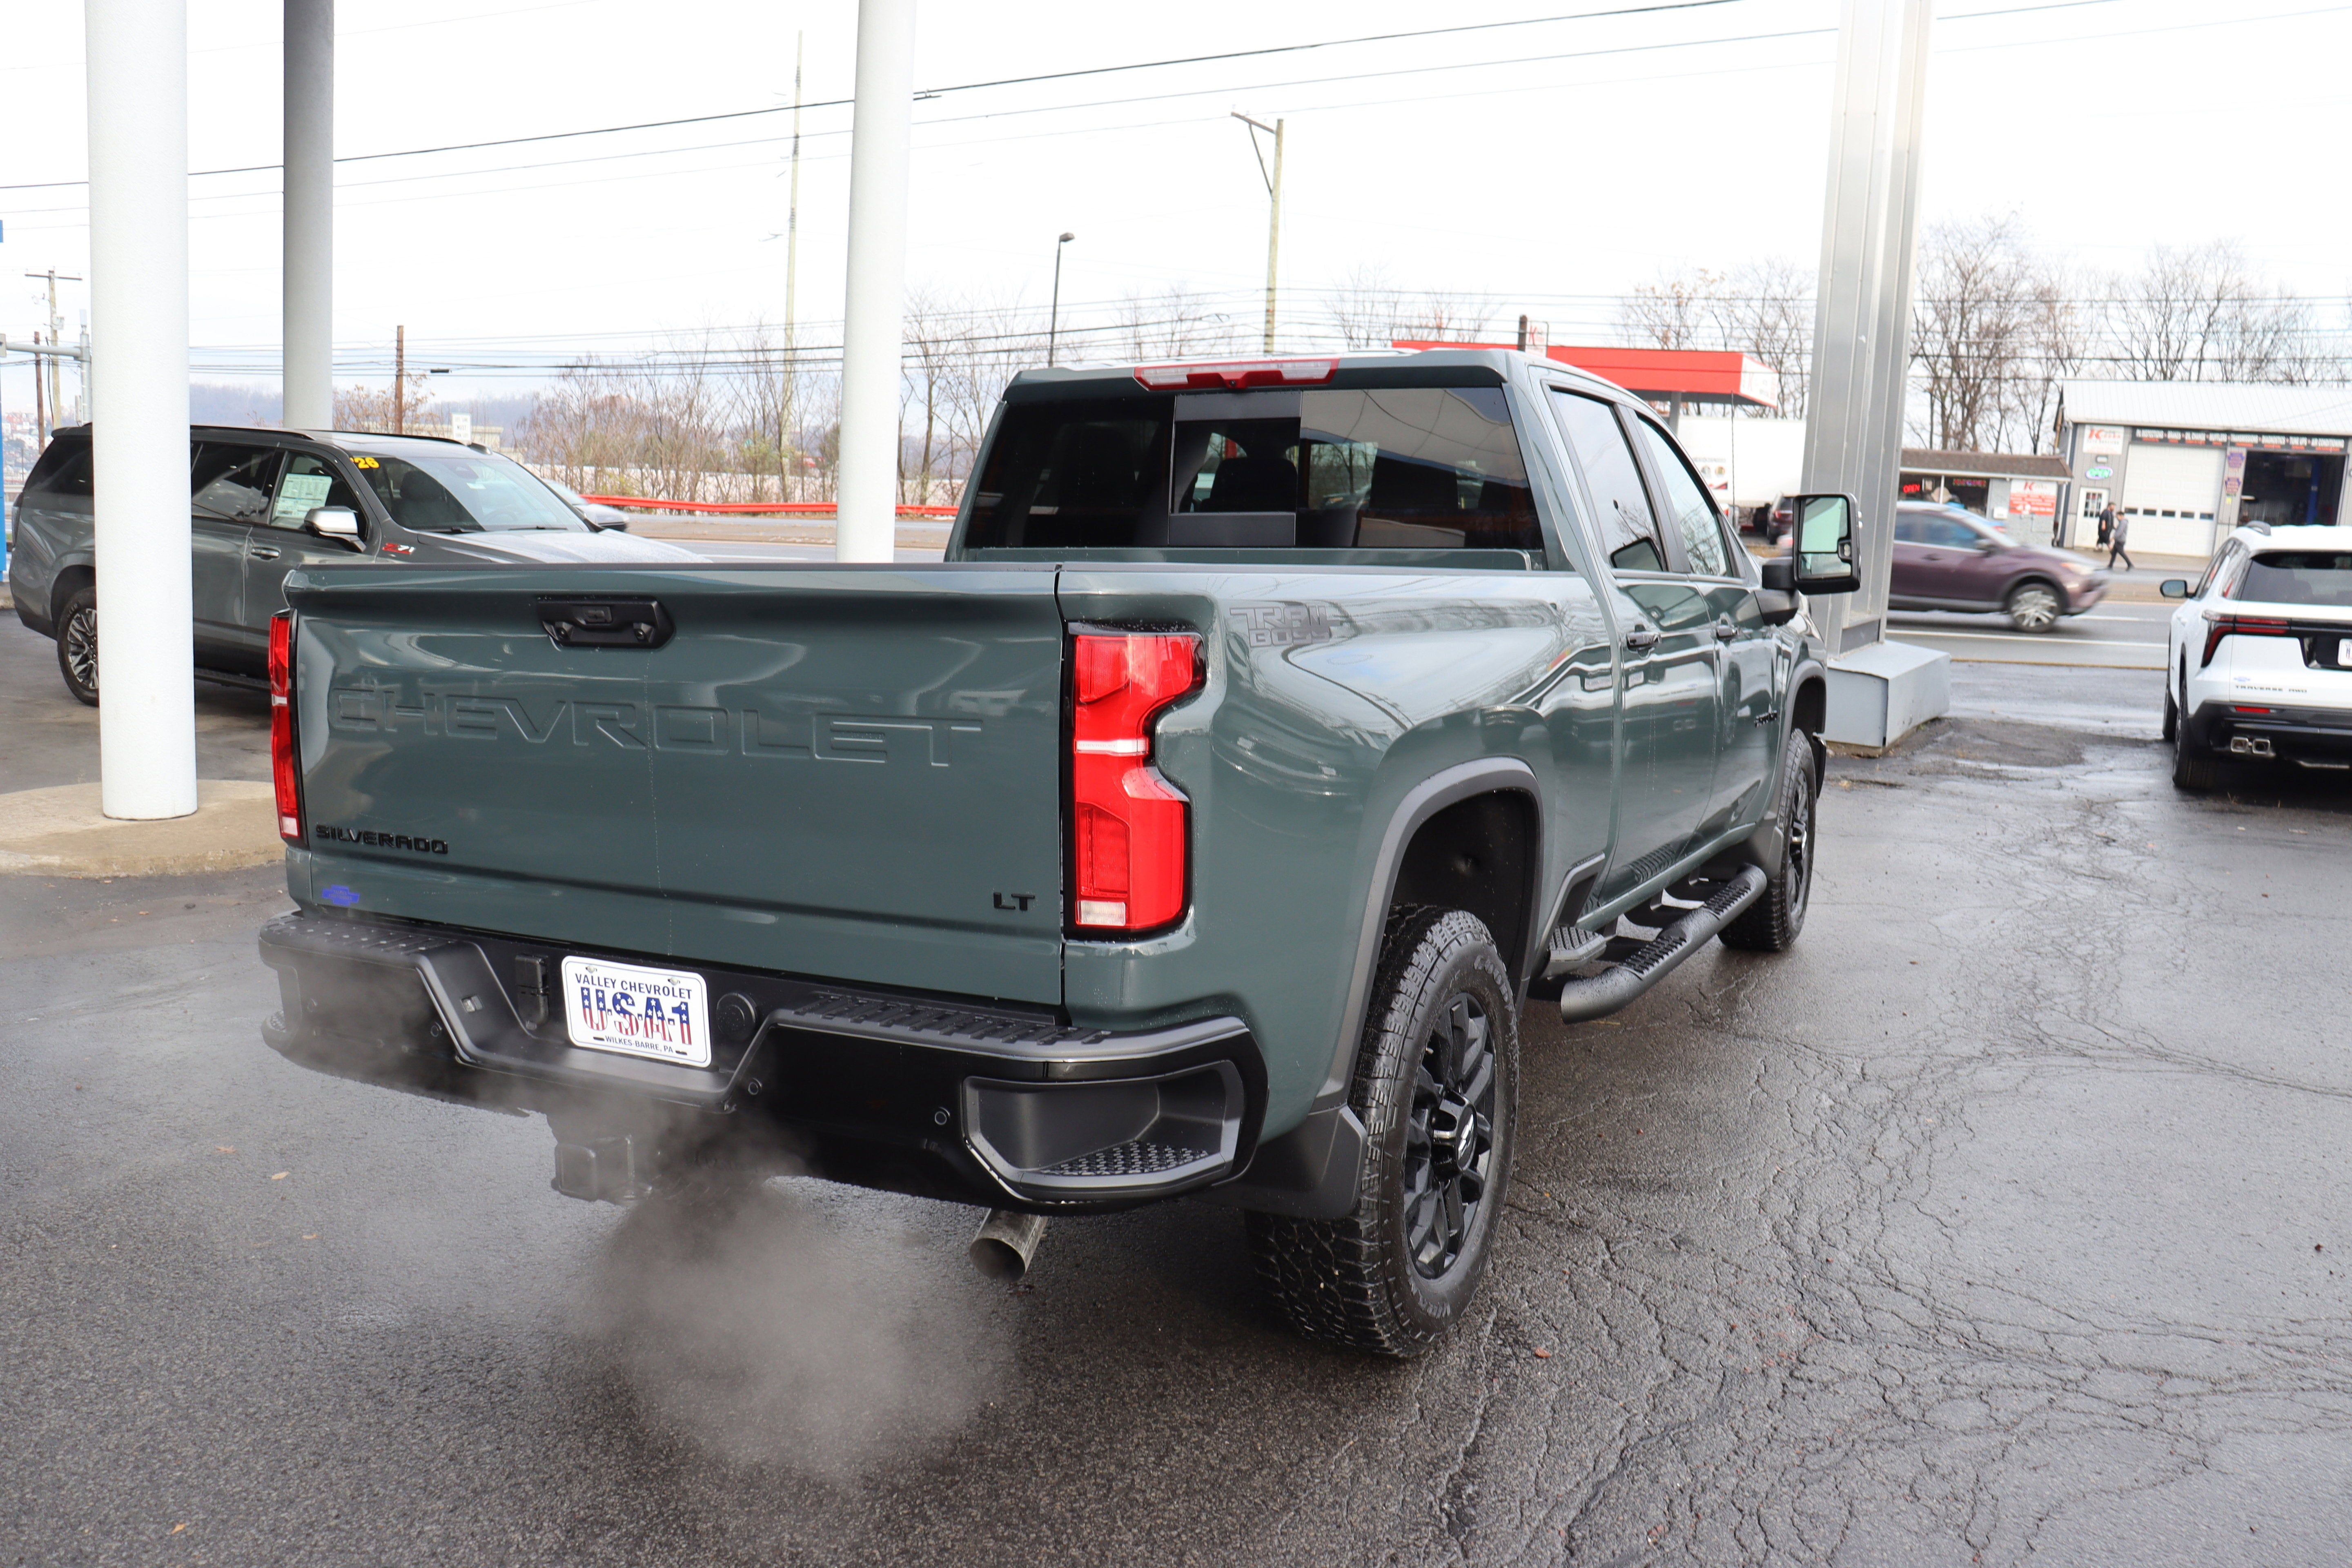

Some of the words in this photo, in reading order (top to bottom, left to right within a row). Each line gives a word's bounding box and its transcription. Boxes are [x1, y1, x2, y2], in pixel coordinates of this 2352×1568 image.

[381, 542, 416, 555] Z71
[1229, 605, 1341, 630] TRAIL
[1249, 627, 1331, 647] BOSS
[327, 687, 984, 767] CHEVROLET
[316, 824, 448, 855] SILVERADO
[993, 892, 1036, 911] LT
[575, 973, 617, 989] VALLEY
[621, 980, 692, 1000] CHEVROLET
[605, 1035, 662, 1052] WILKES-BARRE,
[664, 1045, 674, 1054] PA
